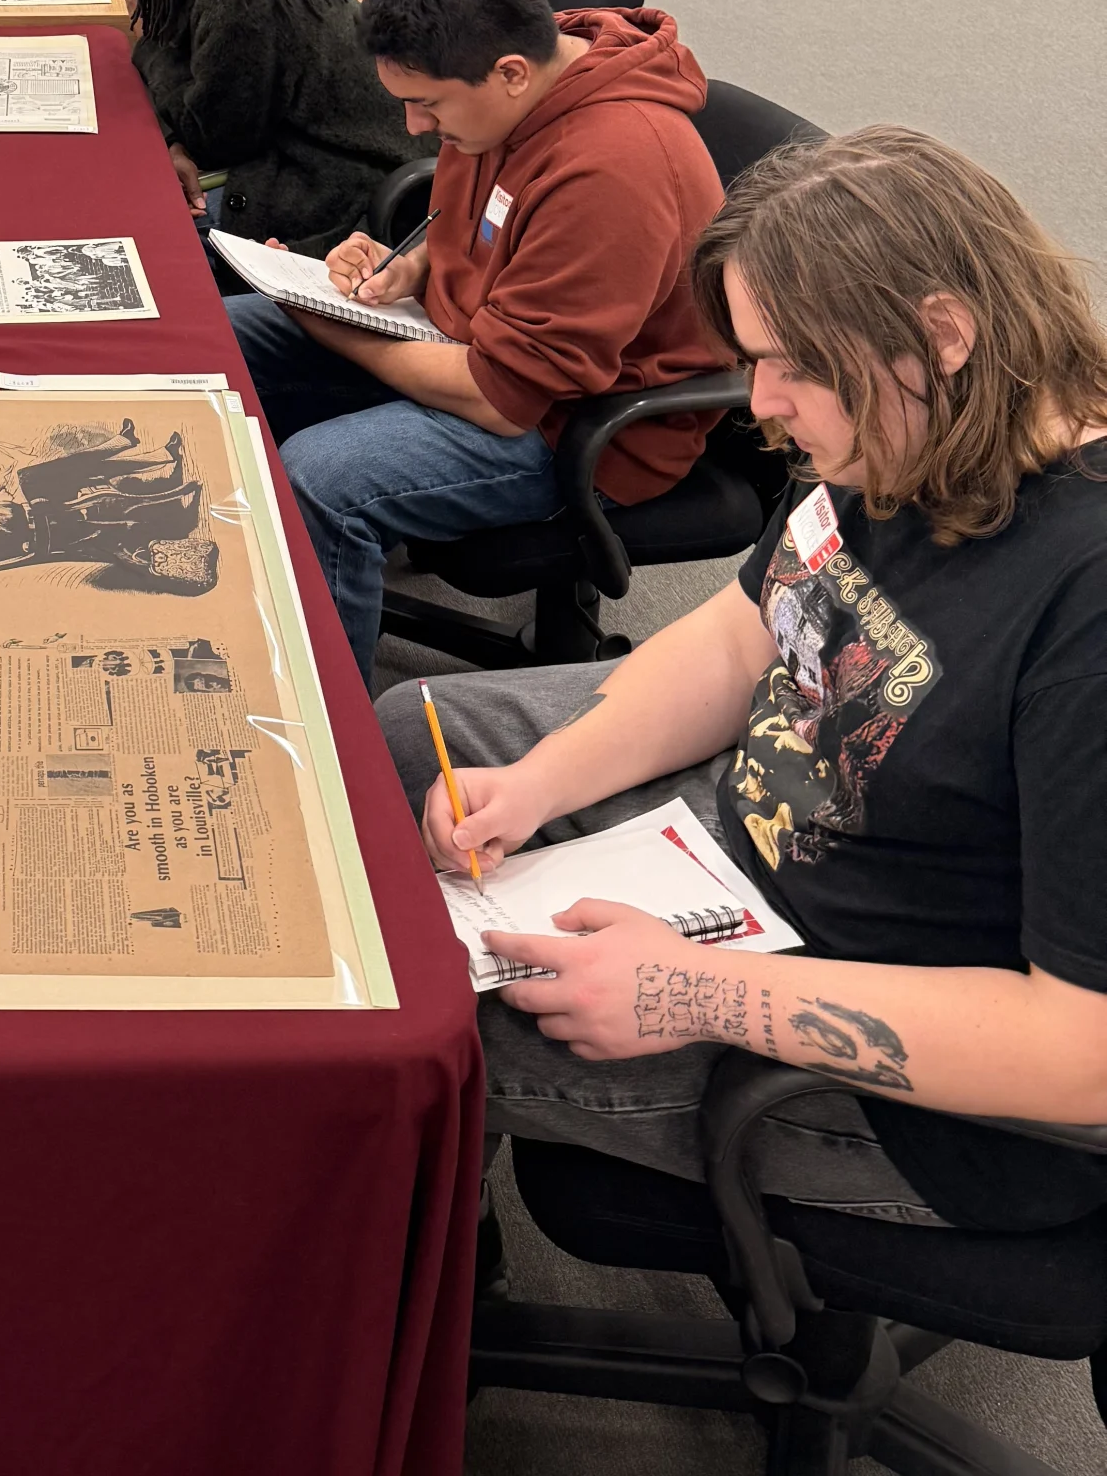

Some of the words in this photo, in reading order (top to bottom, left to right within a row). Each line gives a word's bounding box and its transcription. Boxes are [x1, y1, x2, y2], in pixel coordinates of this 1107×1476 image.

[813, 492, 831, 531] Visitor
[121, 783, 135, 796] as
[142, 756, 161, 812] Hoboken
[167, 785, 181, 805] are
[125, 802, 142, 825] you
[184, 776, 210, 840] Louisville?
[146, 817, 162, 828] in
[172, 810, 190, 832] you
[125, 830, 141, 851] Are
[174, 836, 188, 849] as
[197, 845, 213, 857] in
[148, 833, 171, 881] smooth
